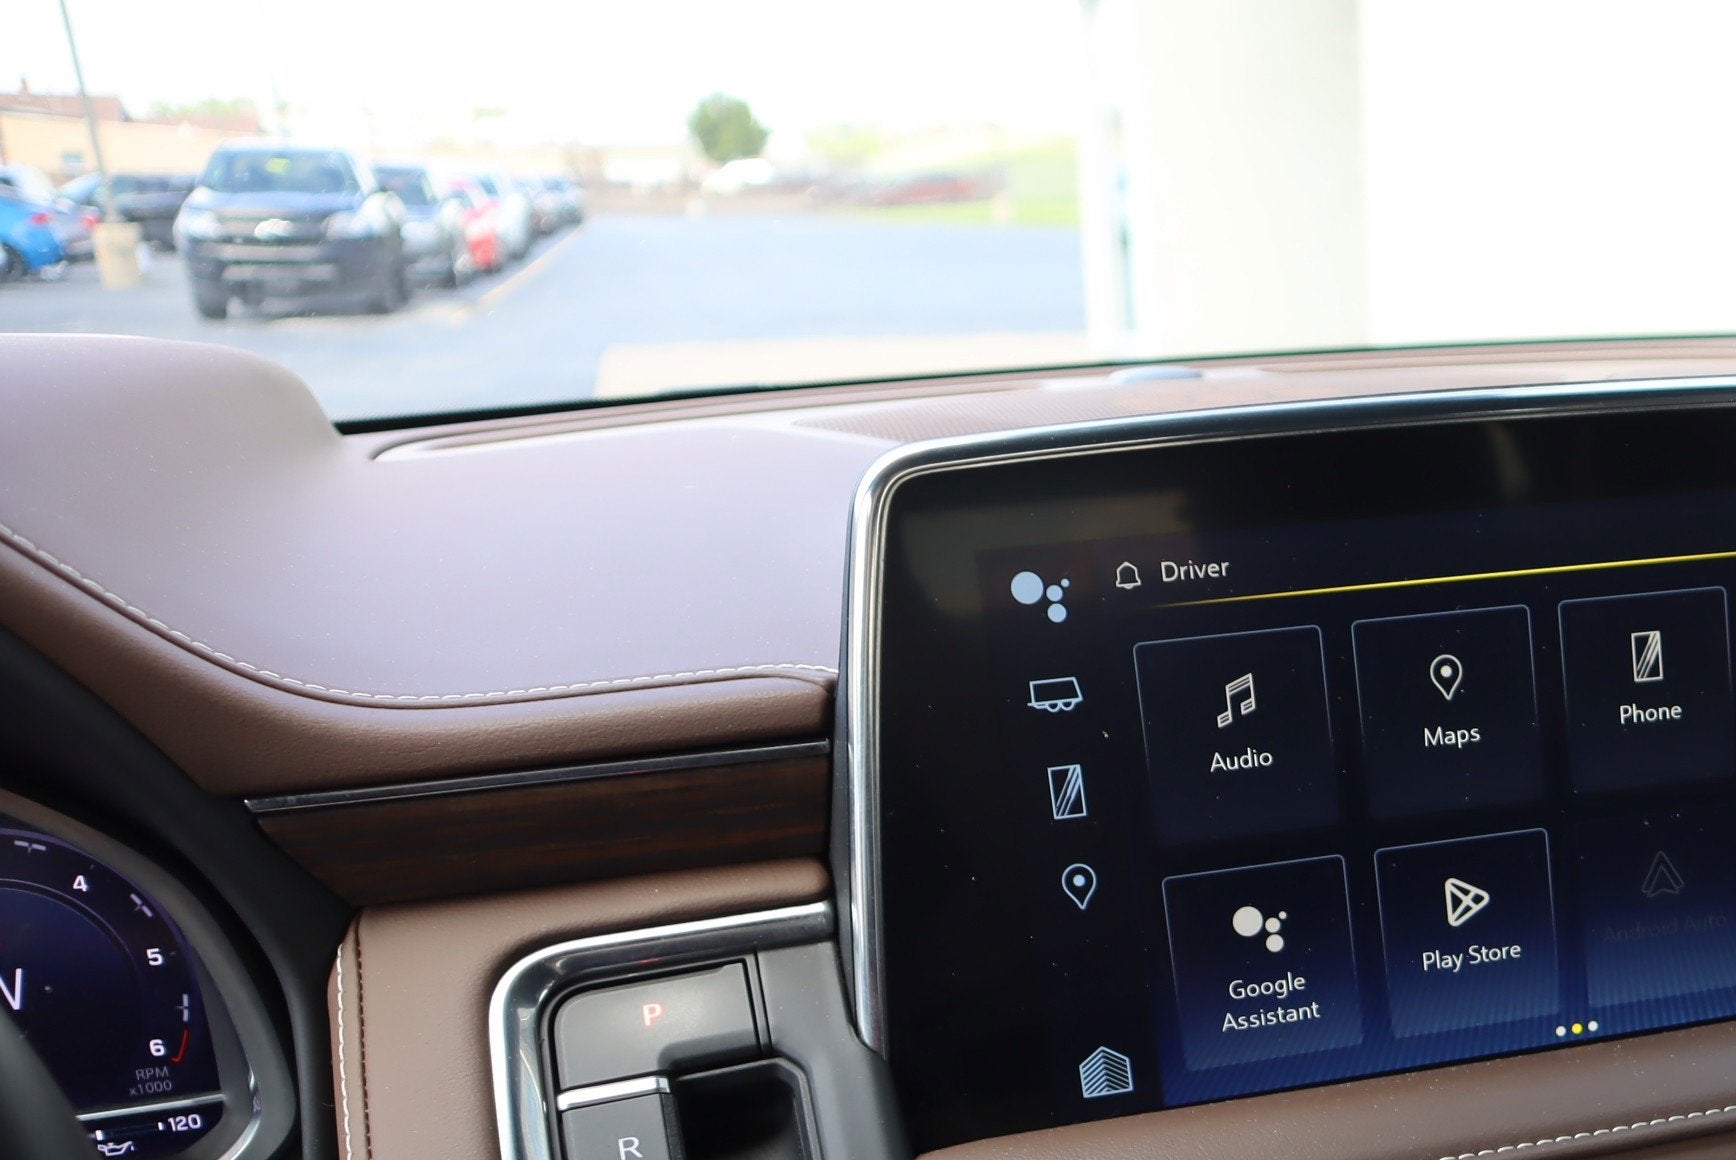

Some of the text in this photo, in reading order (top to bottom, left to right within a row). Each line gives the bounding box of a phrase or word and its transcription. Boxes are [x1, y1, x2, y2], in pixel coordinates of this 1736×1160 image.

[1160, 559, 1230, 582] Driver
[1619, 703, 1682, 725] Phone
[1424, 726, 1481, 749] Maps
[1210, 747, 1273, 773] Audio
[72, 874, 89, 892] 4
[1602, 916, 1679, 943] Android
[146, 947, 164, 966] 5
[1422, 944, 1522, 973] Play Store
[1228, 971, 1306, 1000] Google
[641, 1003, 664, 1027] P
[1222, 1001, 1321, 1032] Assistant
[149, 1038, 166, 1057] 6
[135, 1065, 169, 1081] RPM
[167, 1113, 202, 1132] 120
